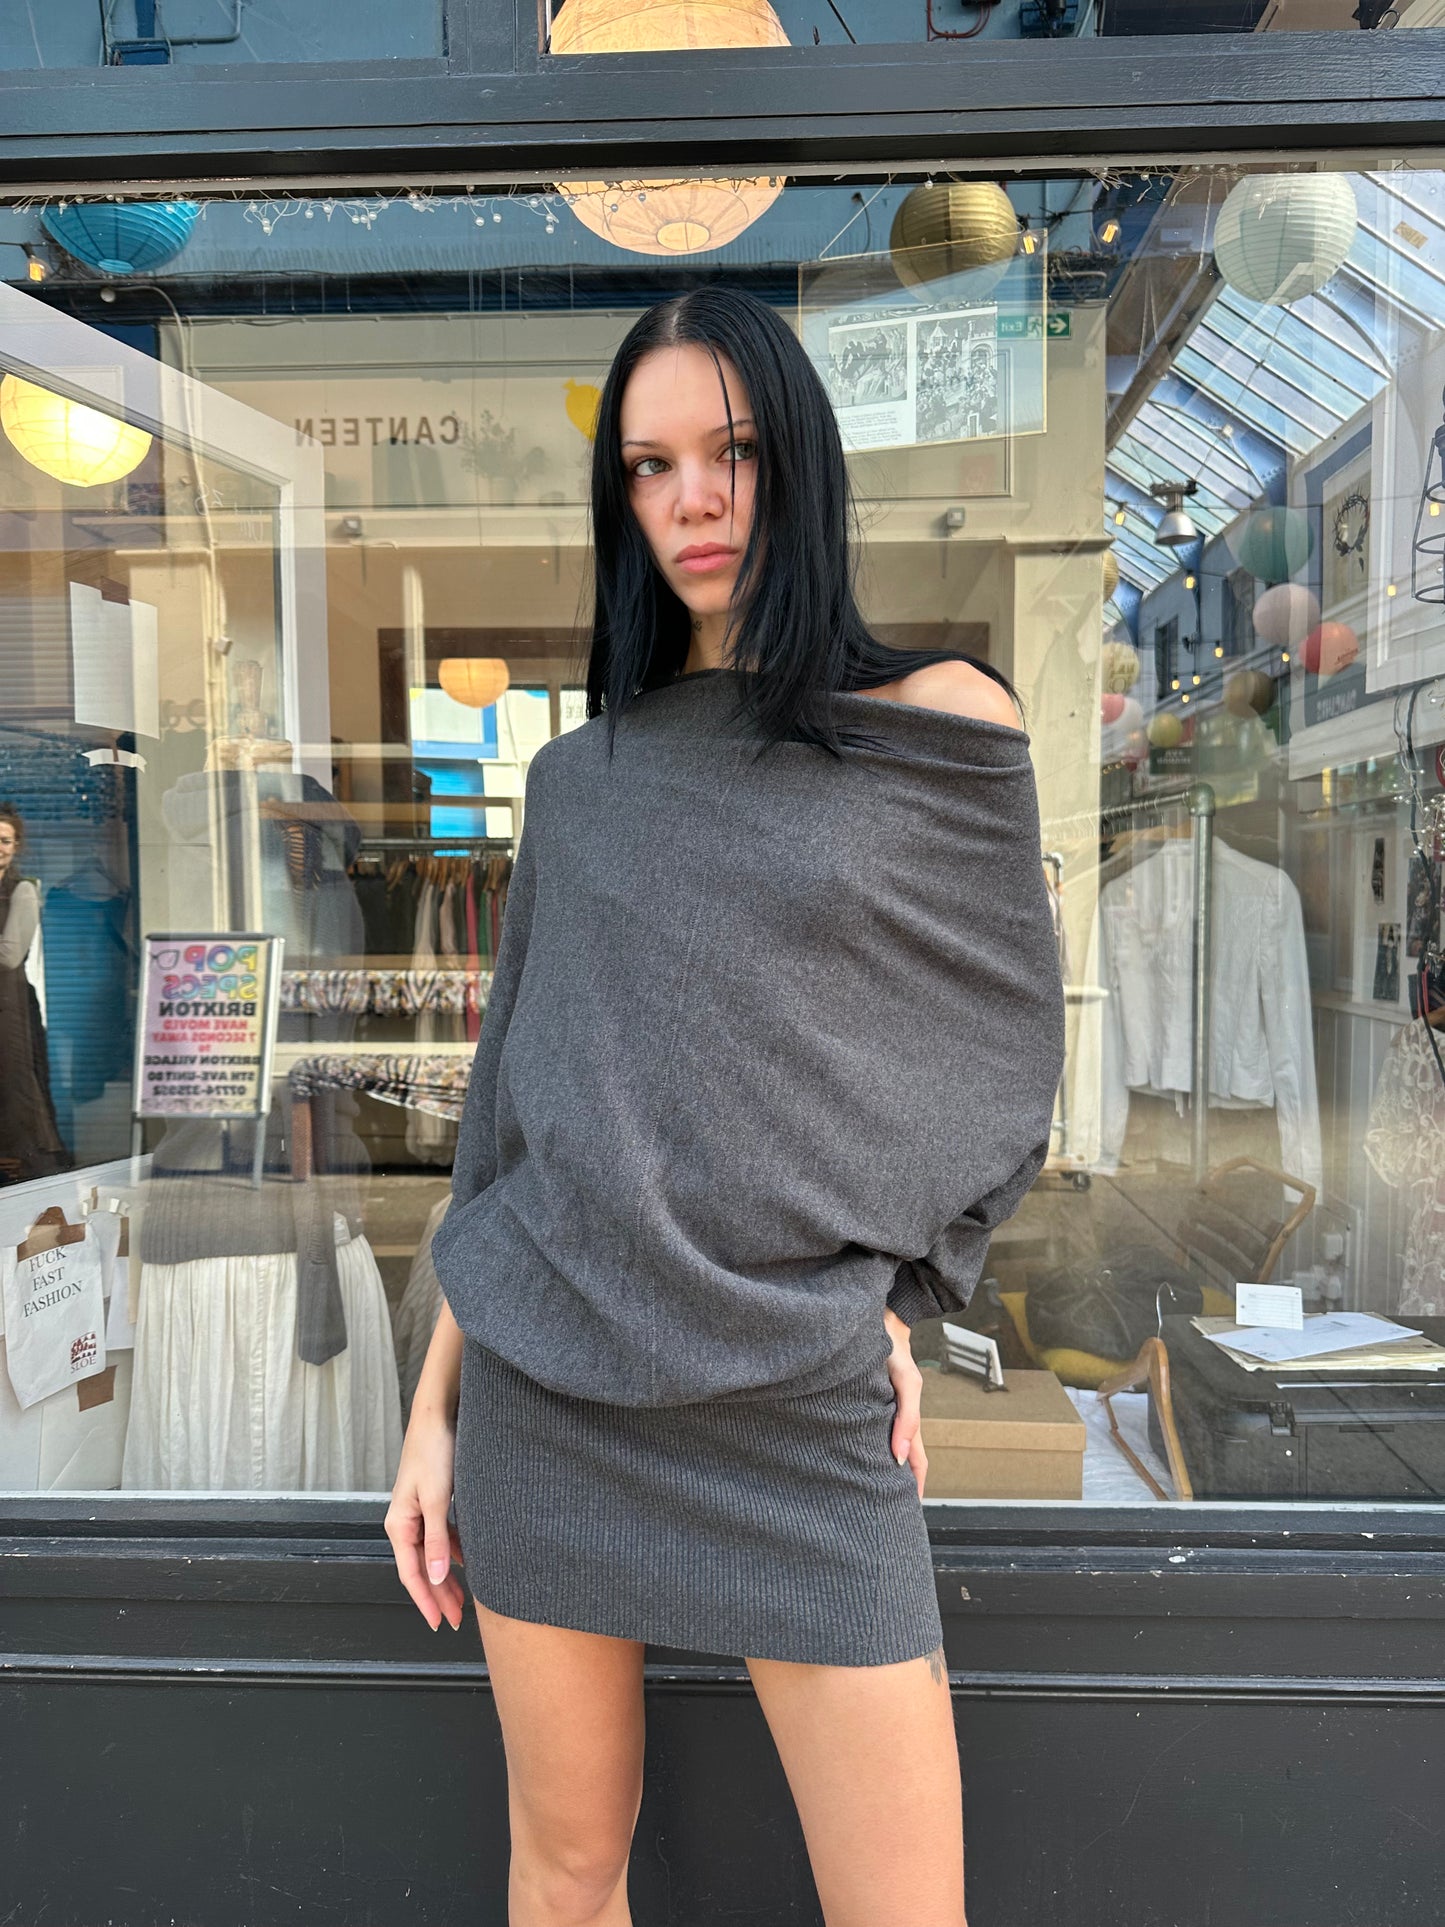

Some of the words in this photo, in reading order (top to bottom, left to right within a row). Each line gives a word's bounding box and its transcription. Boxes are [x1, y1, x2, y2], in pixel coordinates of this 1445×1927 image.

[29, 1246, 67, 1272] FUCK
[32, 1267, 65, 1292] FAST
[23, 1280, 83, 1318] FASHION
[70, 1356, 97, 1374] SLOE
